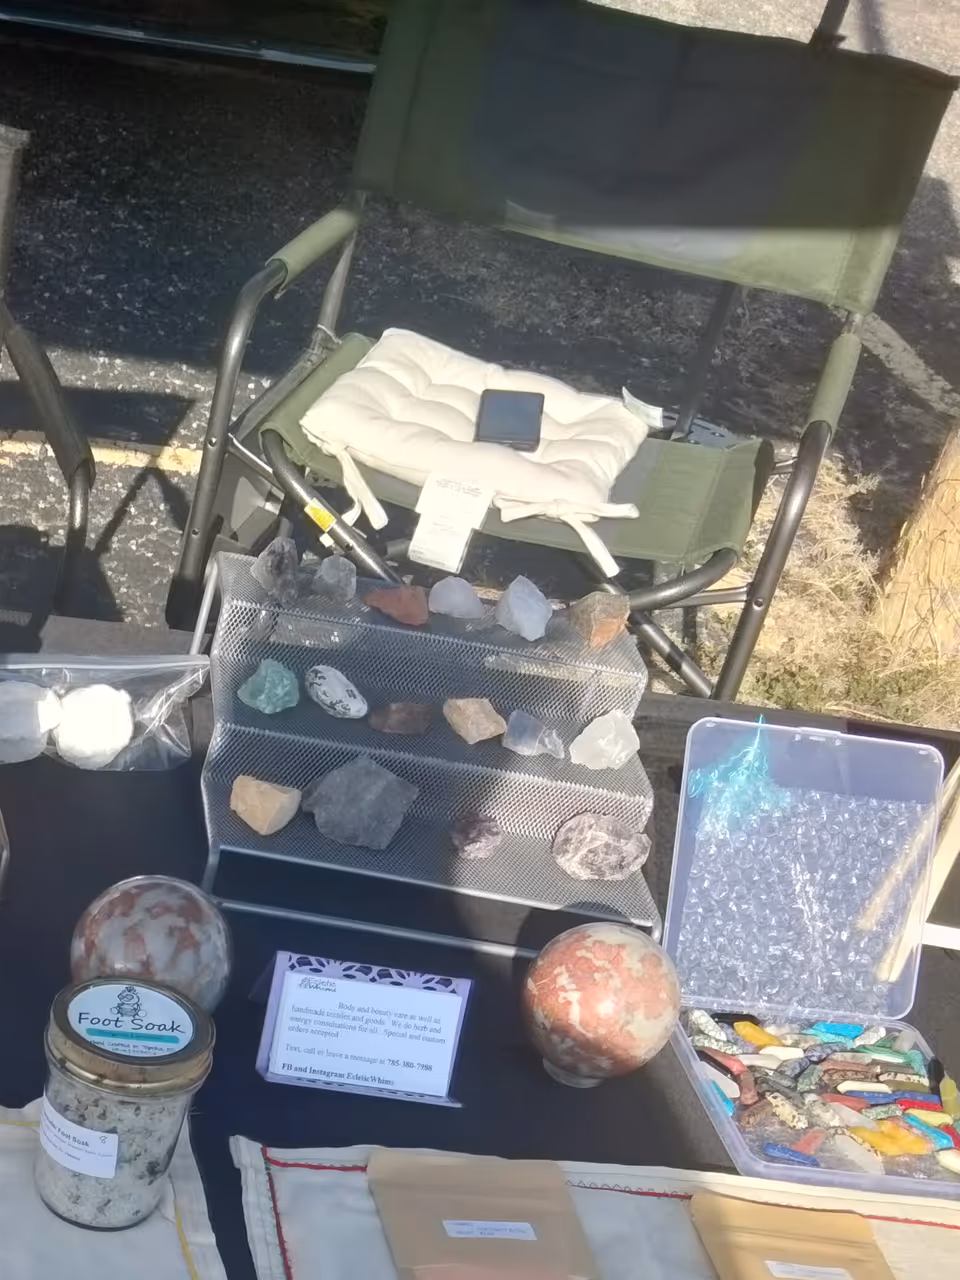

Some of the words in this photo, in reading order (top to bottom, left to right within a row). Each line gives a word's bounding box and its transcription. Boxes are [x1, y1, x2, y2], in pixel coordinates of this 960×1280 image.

[291, 1004, 325, 1017] handmade
[351, 1014, 364, 1022] and
[391, 1019, 402, 1028] We
[403, 1021, 412, 1029] do
[413, 1023, 428, 1032] herb
[429, 1026, 442, 1034] and
[338, 1001, 355, 1012] Body
[356, 1006, 370, 1014] and
[418, 1014, 433, 1022] well
[77, 1011, 126, 1029] Foot
[130, 1017, 187, 1035] Soak
[287, 1024, 309, 1034] orders
[289, 1016, 312, 1025] energy
[313, 1018, 357, 1031] consultations
[357, 1024, 368, 1033] for
[383, 1029, 408, 1038] Special
[408, 1033, 421, 1041] and
[303, 1047, 316, 1055] call
[326, 1048, 343, 1059] leave
[281, 1062, 293, 1071] FB
[293, 1066, 307, 1074] and
[308, 1066, 345, 1078] Instagram
[71, 1136, 90, 1147] Soak
